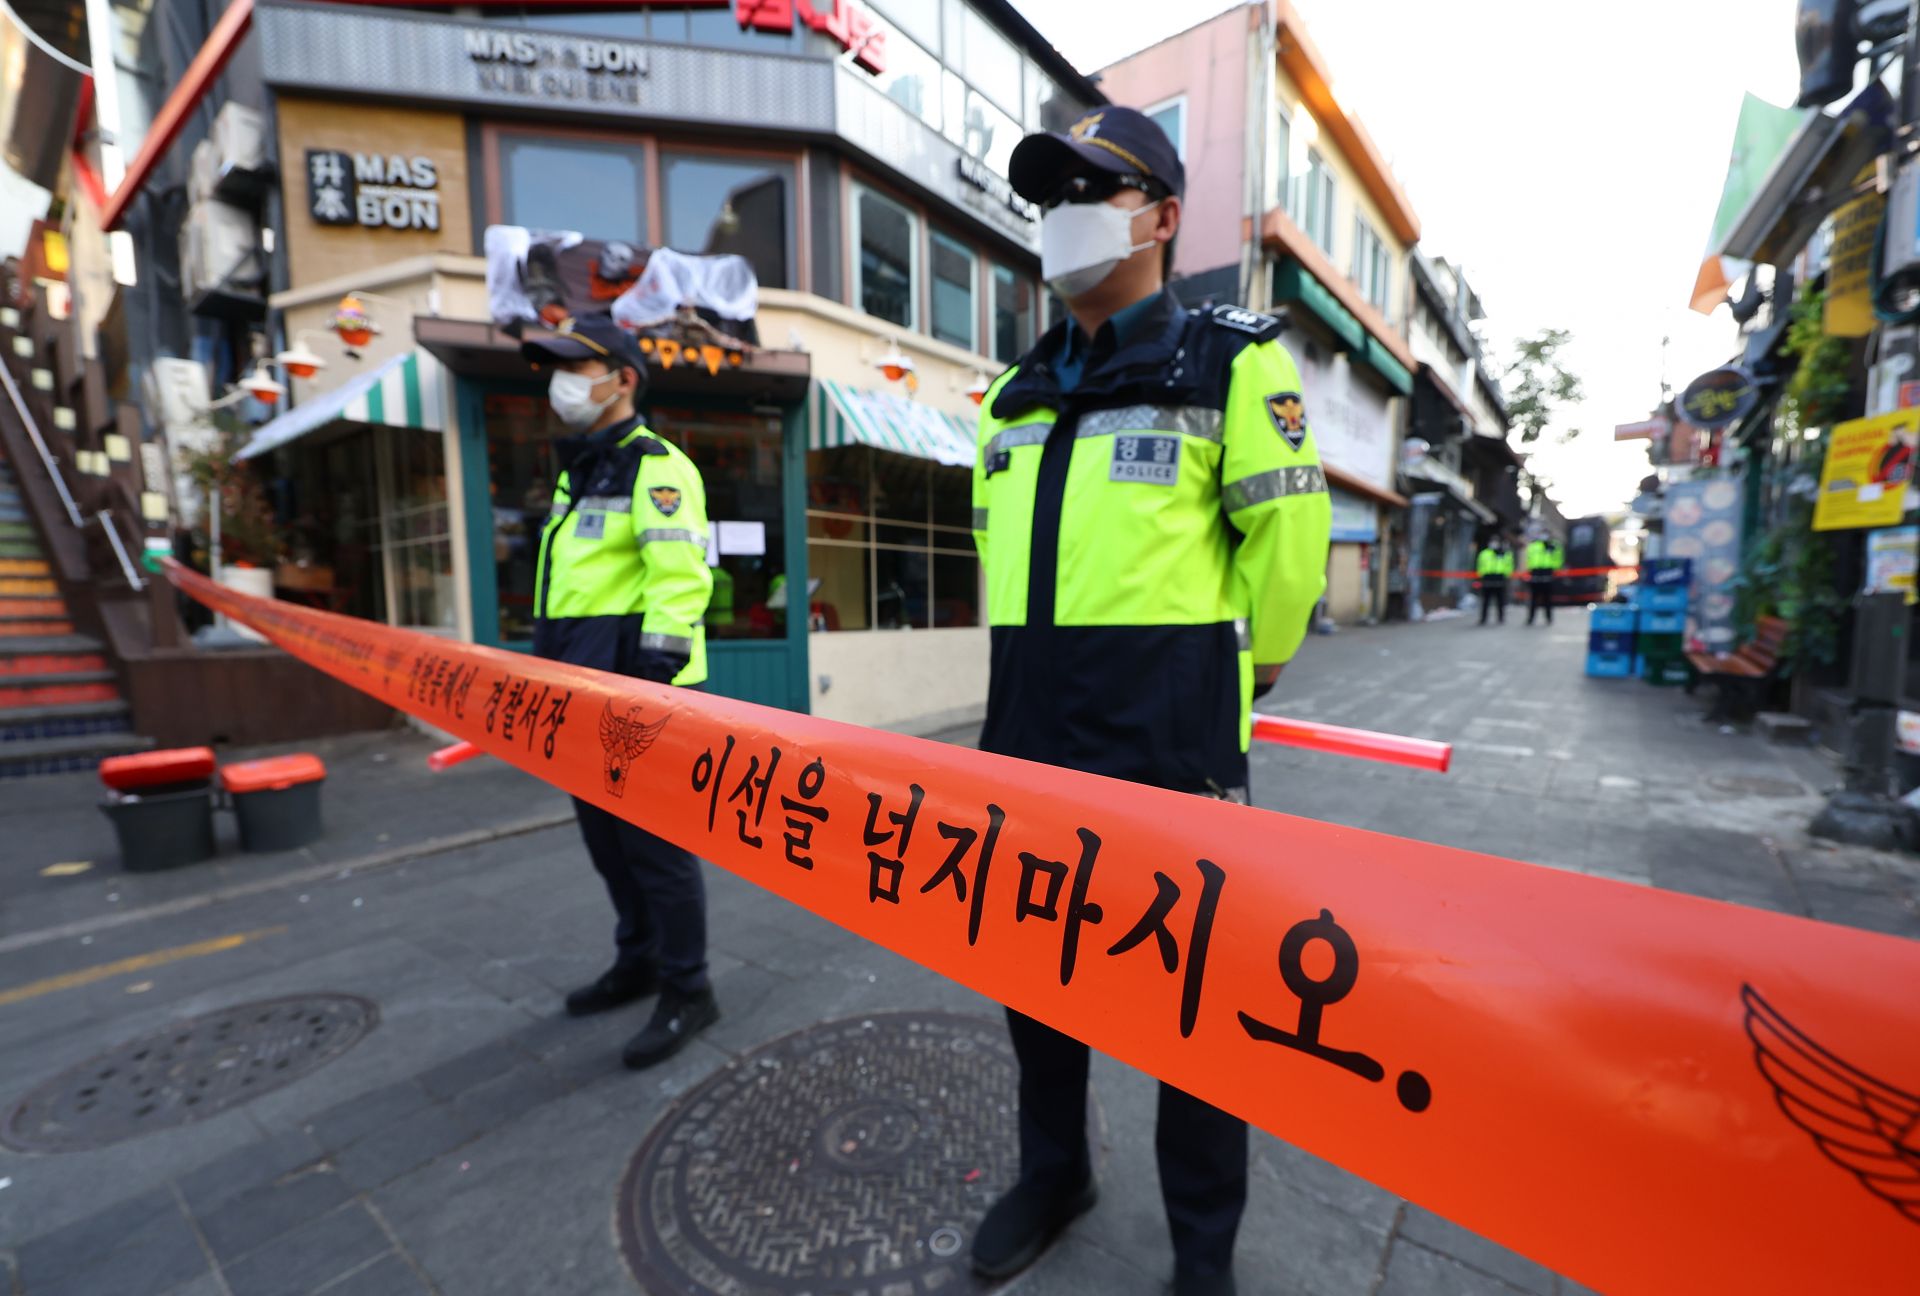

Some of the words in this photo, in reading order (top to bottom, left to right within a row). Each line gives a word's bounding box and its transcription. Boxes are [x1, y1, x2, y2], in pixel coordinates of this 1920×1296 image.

[464, 29, 537, 64] MAS
[579, 41, 650, 76] BON
[354, 152, 437, 188] MAS
[356, 195, 439, 231] BON
[1116, 464, 1172, 479] POLICE
[483, 674, 572, 759] 경찰서장
[691, 734, 829, 871] 이선을
